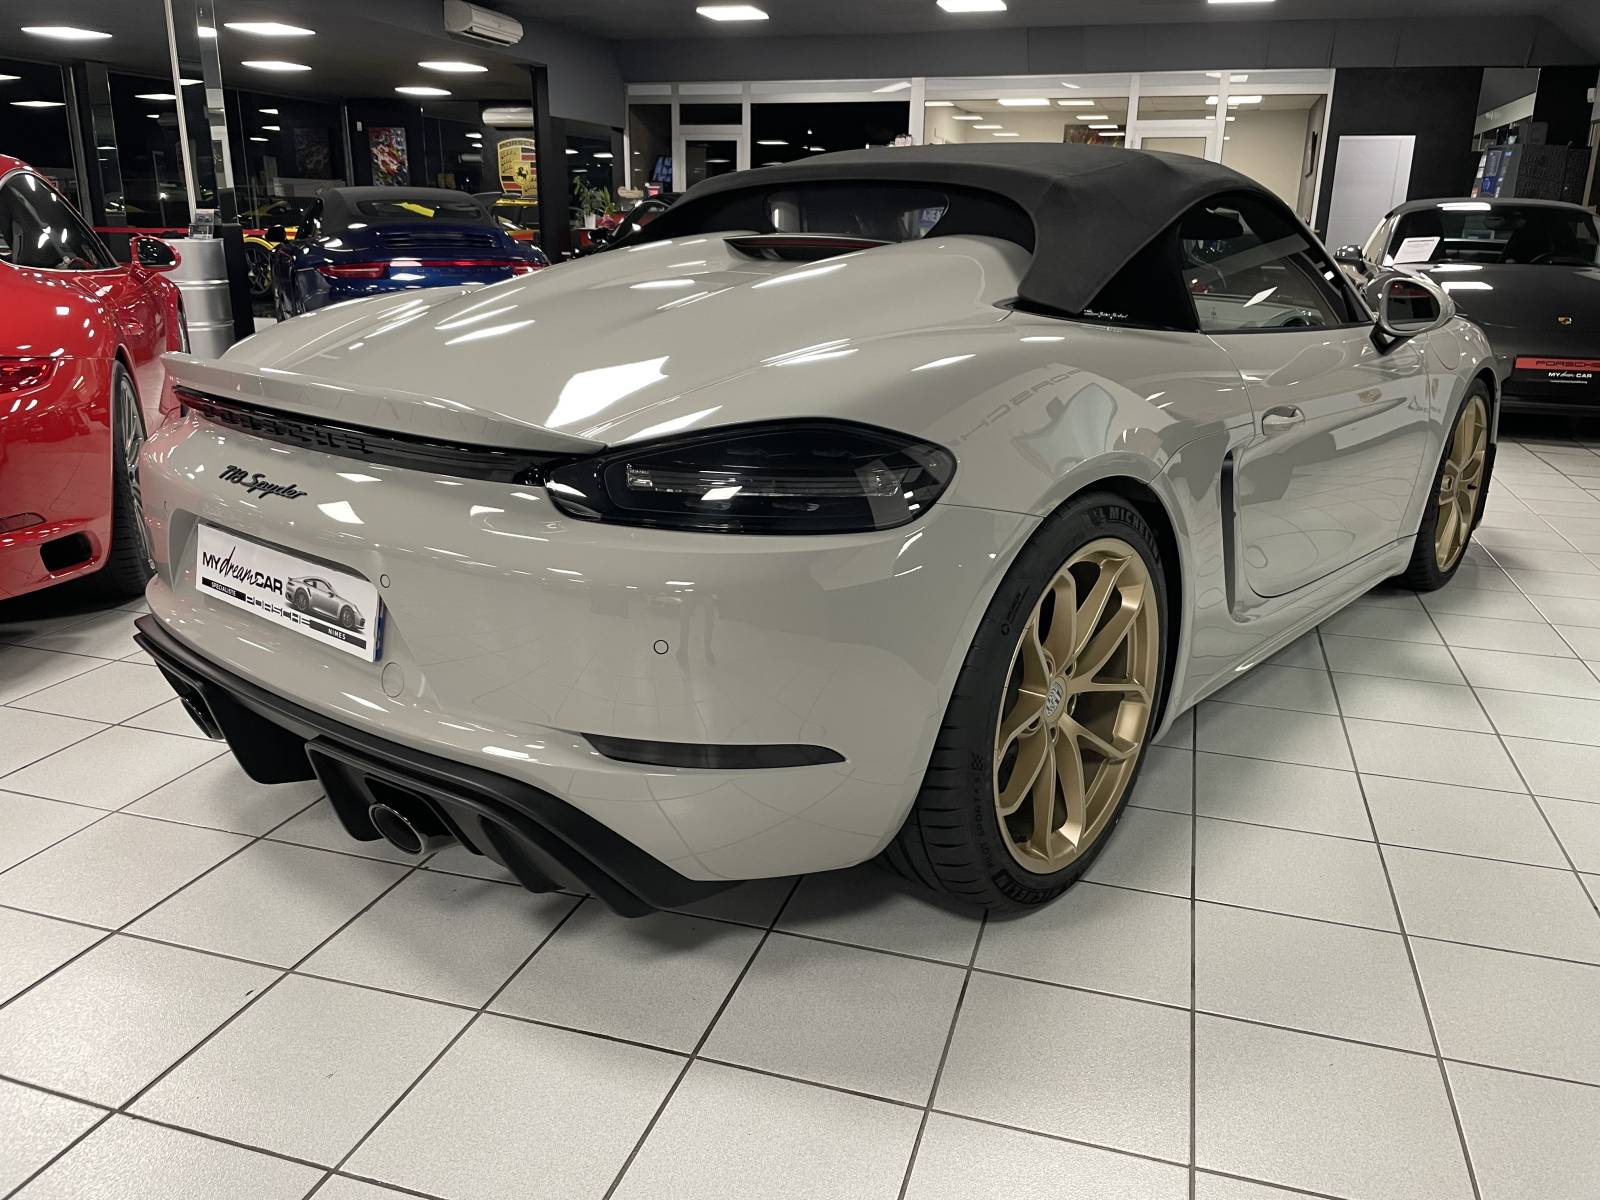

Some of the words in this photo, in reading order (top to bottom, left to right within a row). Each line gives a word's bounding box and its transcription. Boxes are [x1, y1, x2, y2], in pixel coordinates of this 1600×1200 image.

[218, 464, 243, 485] 718
[241, 472, 307, 499] Spyder
[202, 551, 222, 570] MY
[219, 545, 258, 585] dream
[255, 571, 283, 595] CAR
[246, 595, 311, 626] PORSCHE
